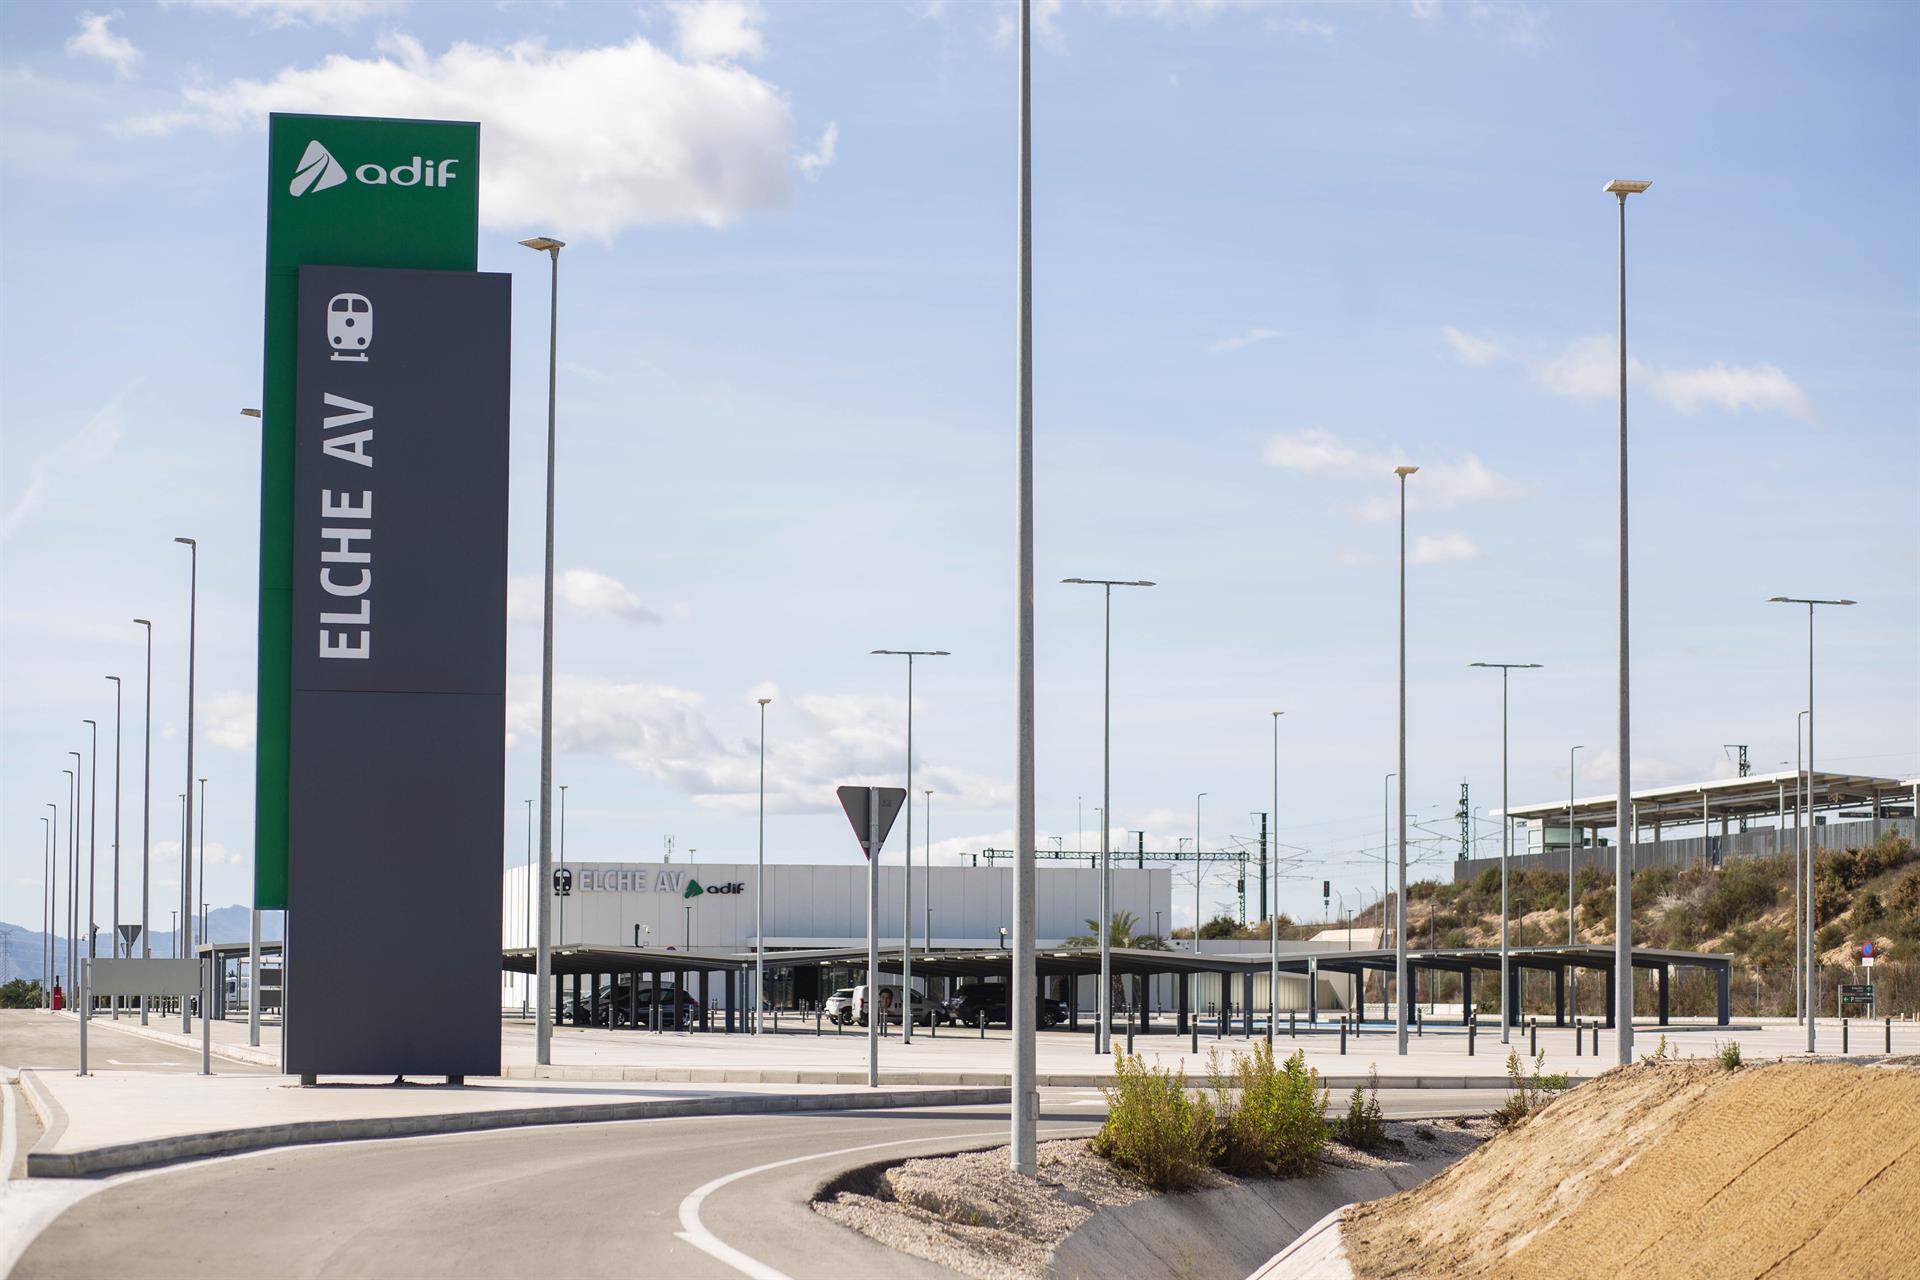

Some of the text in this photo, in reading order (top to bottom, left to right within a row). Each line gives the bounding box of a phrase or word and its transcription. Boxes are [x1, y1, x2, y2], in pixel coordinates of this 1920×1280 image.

[354, 156, 460, 189] adif
[319, 392, 375, 660] ELCHE AV
[578, 870, 685, 892] ELCHE AV
[706, 882, 745, 894] adif
